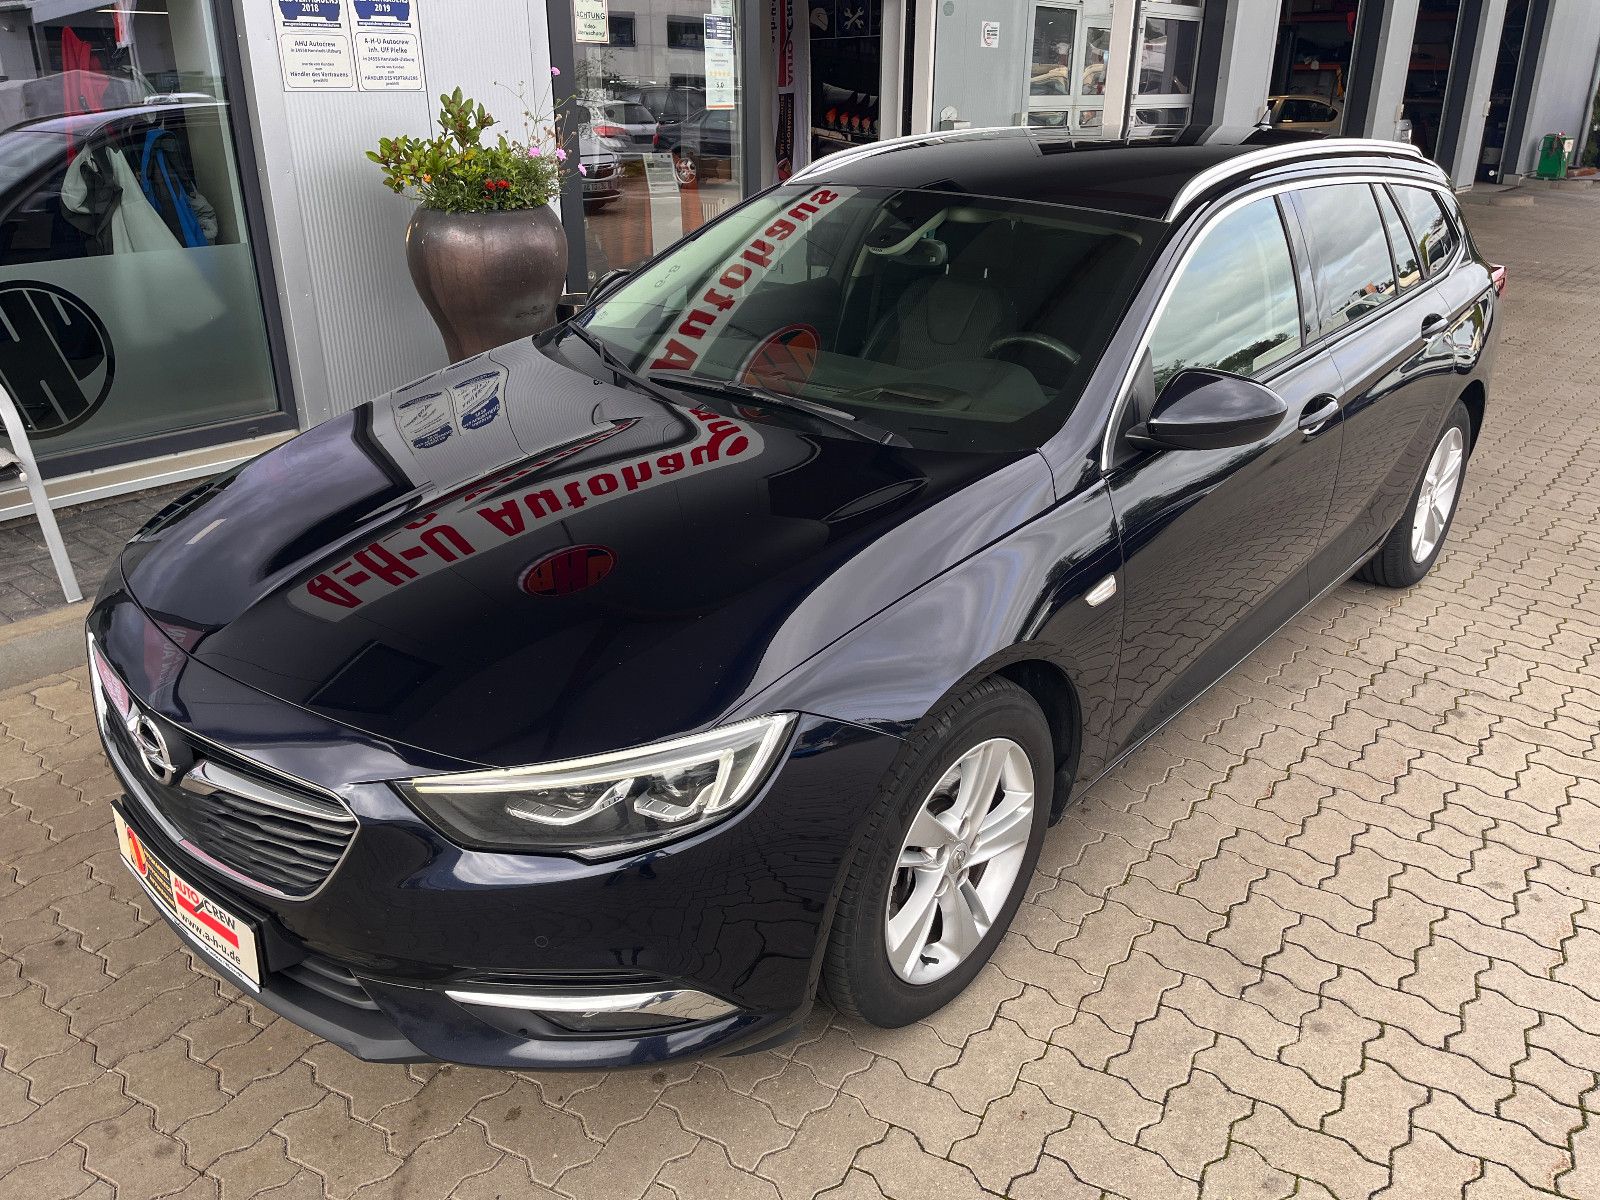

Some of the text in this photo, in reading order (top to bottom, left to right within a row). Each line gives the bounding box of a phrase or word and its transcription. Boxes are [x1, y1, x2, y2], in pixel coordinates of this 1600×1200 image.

[301, 3, 320, 12] 2018
[374, 3, 391, 12] 2019
[576, 10, 606, 20] ACHTUNG
[309, 40, 336, 48] Autocrew
[174, 877, 200, 905] AUTO
[203, 898, 236, 931] CREW
[178, 911, 241, 965] www.a-h-u.de
